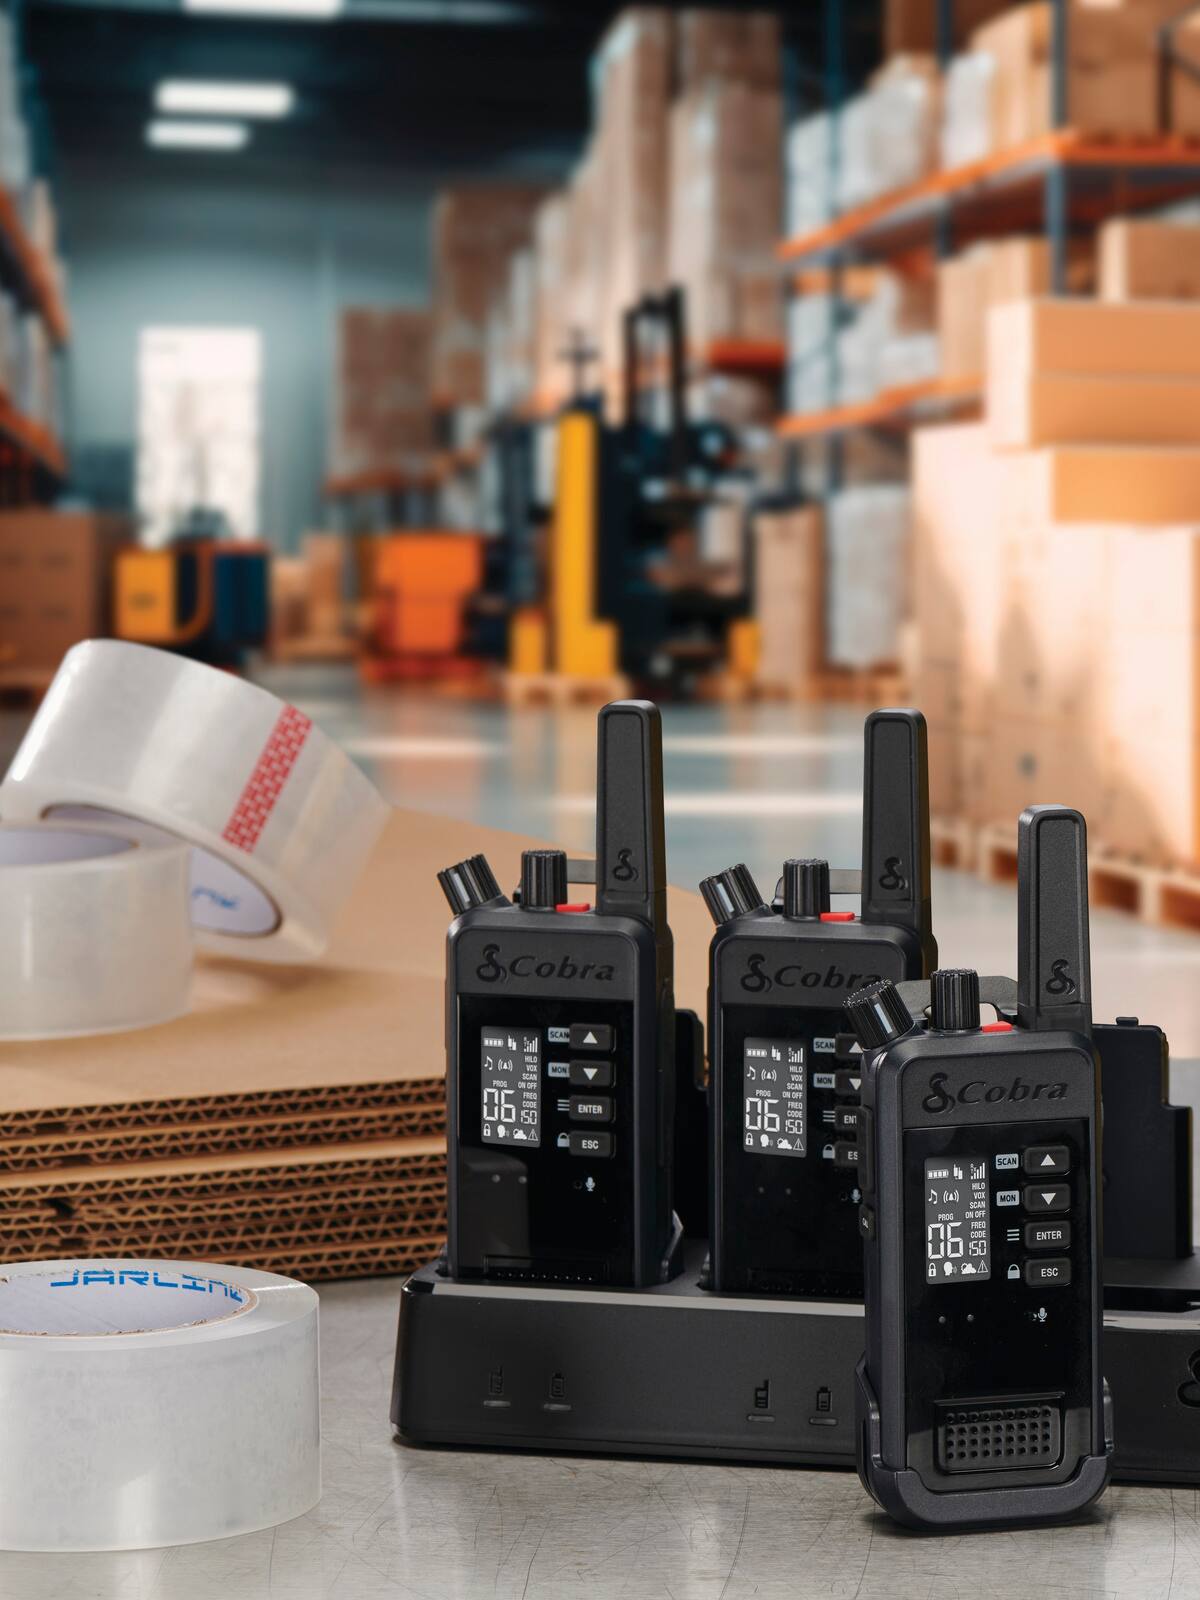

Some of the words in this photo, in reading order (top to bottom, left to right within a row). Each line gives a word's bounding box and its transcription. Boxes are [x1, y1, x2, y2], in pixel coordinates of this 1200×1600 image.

[509, 955, 615, 981] Cobra
[550, 1029, 570, 1038] SCAN
[815, 1040, 835, 1048] SCAN
[817, 1076, 832, 1084] MON
[957, 1077, 1068, 1104] Cobra
[483, 1088, 516, 1122] 06
[578, 1104, 602, 1114] ENTER
[746, 1097, 780, 1132] 06
[844, 1115, 856, 1124] ENT
[582, 1140, 599, 1149] ESC
[848, 1151, 858, 1160] ES
[998, 1157, 1016, 1166] SCAN
[1036, 1230, 1062, 1240] ENTER
[928, 1222, 963, 1259] 06
[1041, 1268, 1058, 1277] ESC
